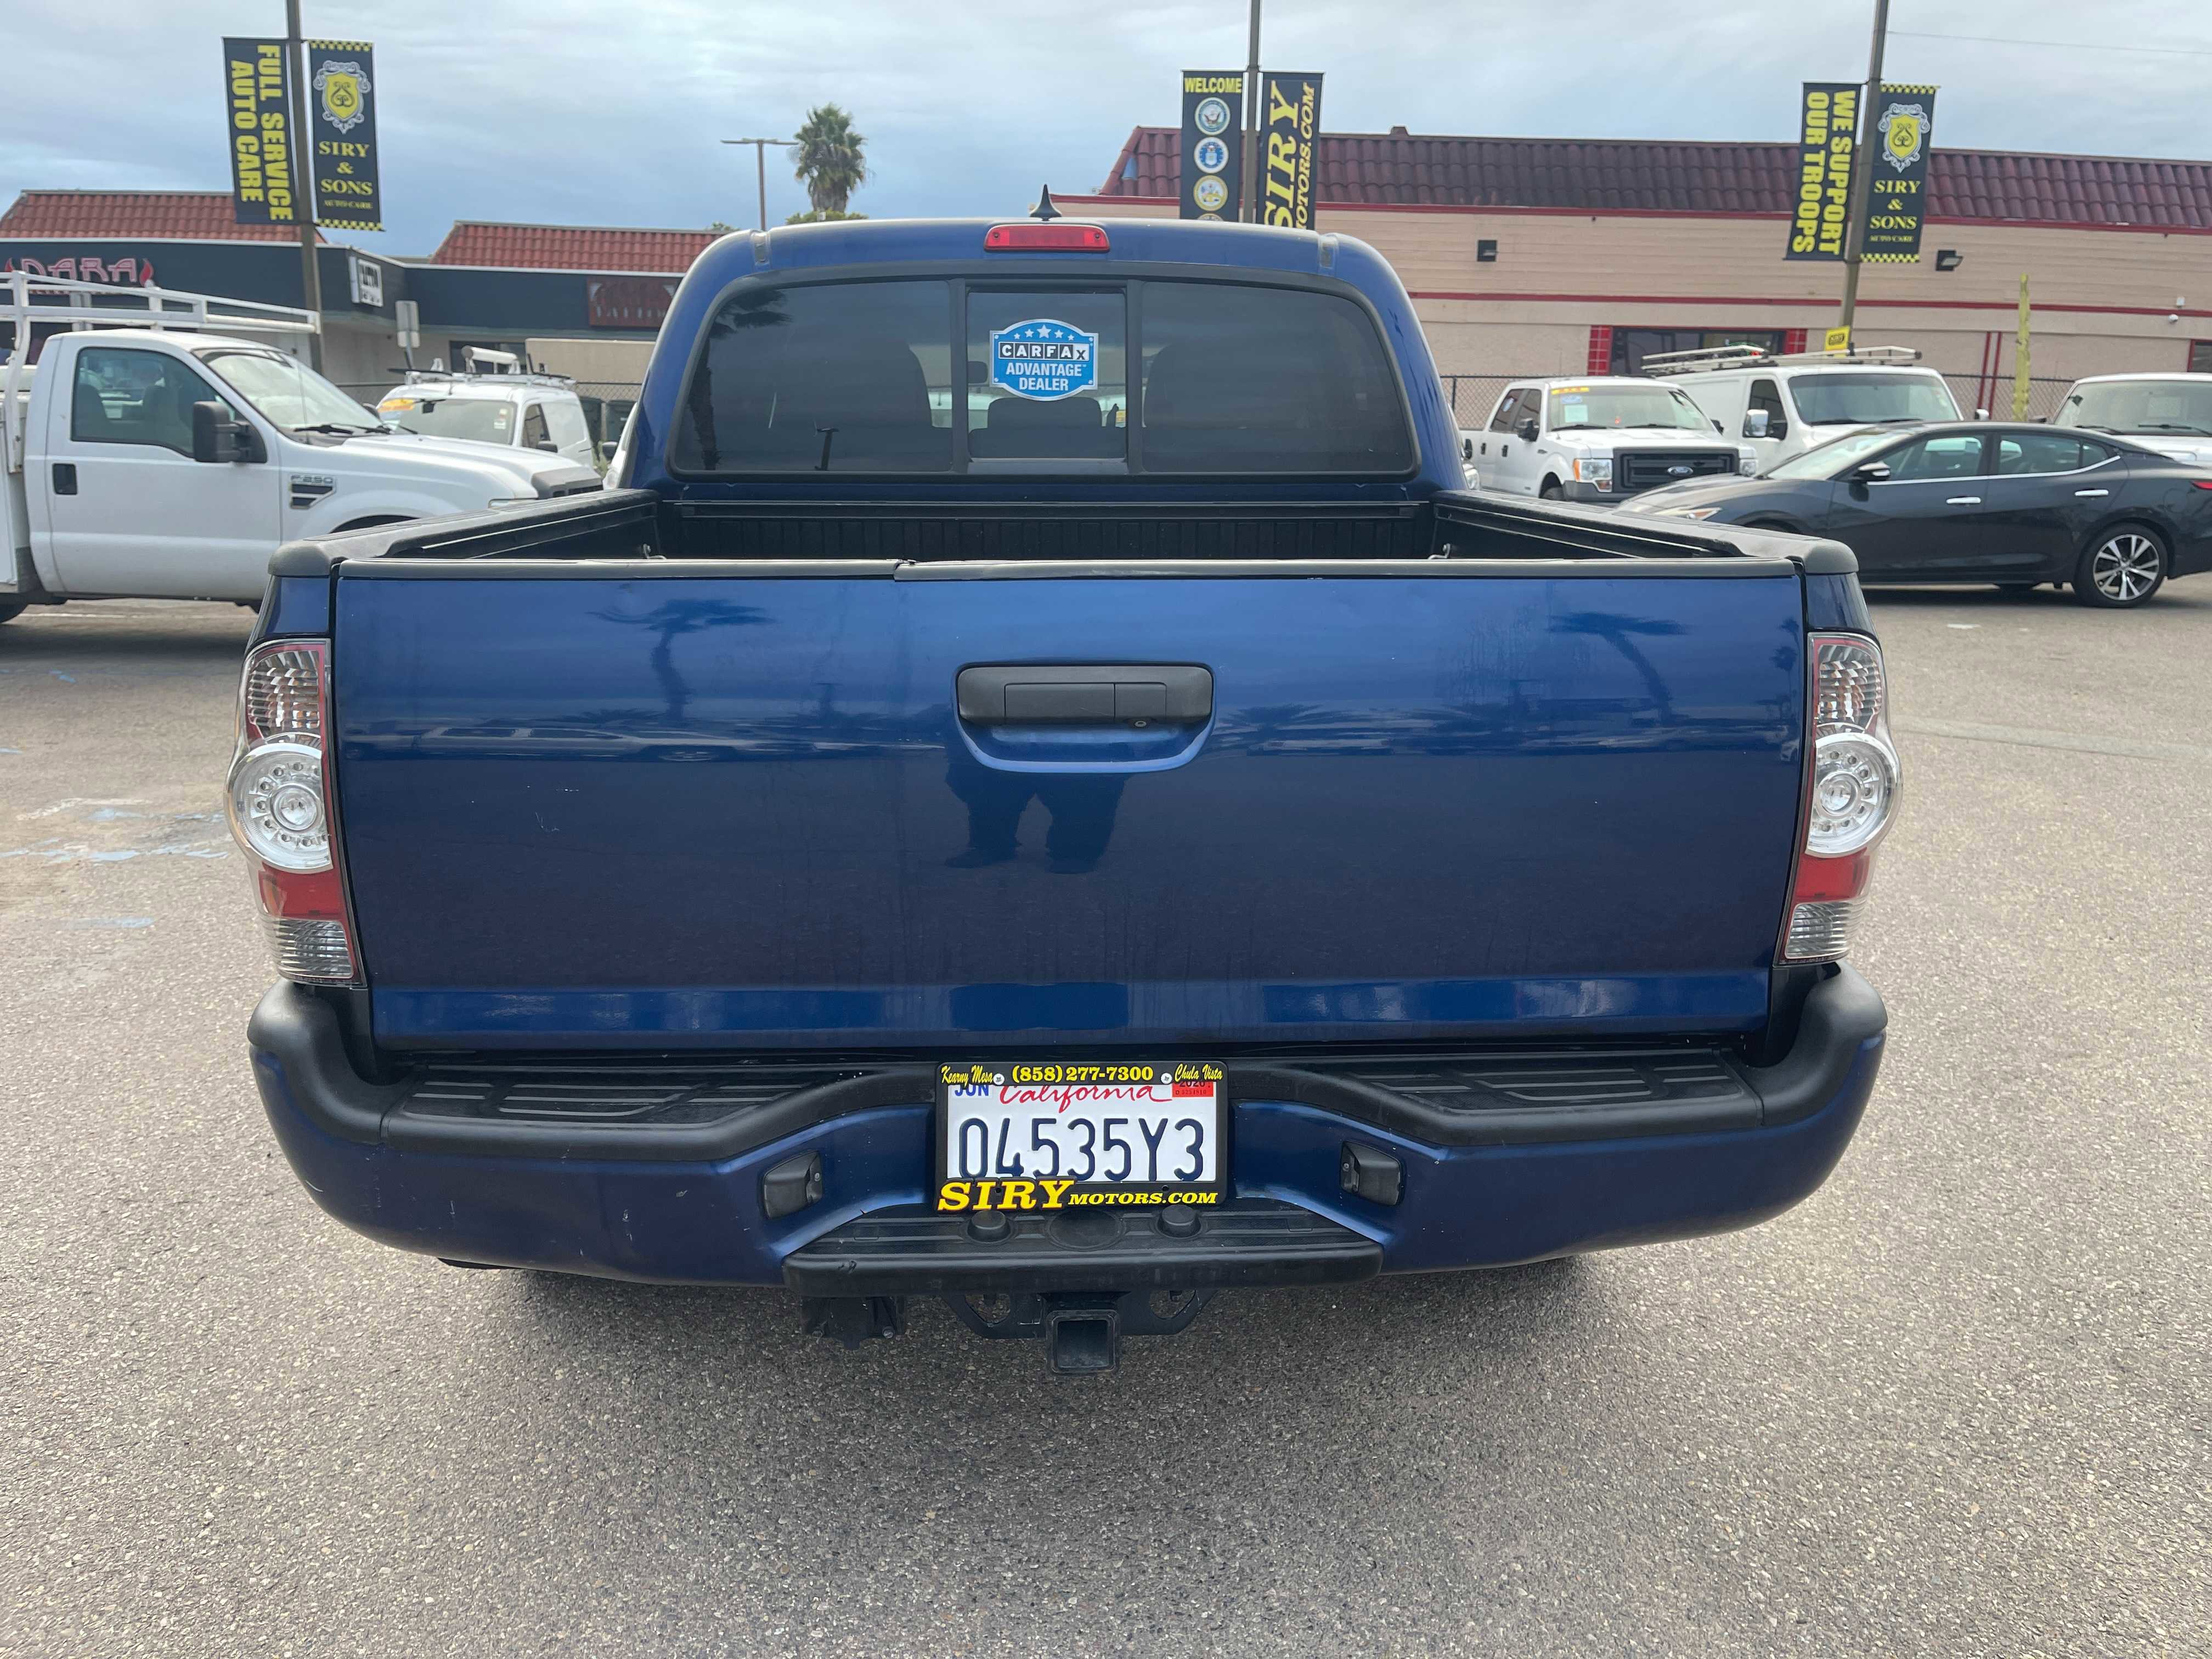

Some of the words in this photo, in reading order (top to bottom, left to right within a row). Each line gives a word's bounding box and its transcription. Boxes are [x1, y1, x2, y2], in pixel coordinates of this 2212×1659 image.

[257, 45, 283, 101] FULL
[231, 60, 258, 129] AUTO
[1184, 77, 1242, 93] WELCOME
[1805, 92, 1830, 145] OUR
[1832, 90, 1856, 132] WE
[319, 141, 370, 157] SIRY
[1264, 80, 1299, 228] SIRY
[236, 135, 264, 202] CARE
[261, 112, 294, 221] SERVICE
[337, 162, 354, 174] &
[320, 179, 373, 195] SONS
[1819, 137, 1853, 256] SUPPORT
[1874, 180, 1921, 194] SIRY
[1792, 149, 1826, 253] TROOPS
[1887, 199, 1904, 211] &
[1869, 216, 1917, 230] SONS
[1002, 345, 1086, 360] CARFAX
[1006, 363, 1082, 377] ADVANTAGE
[1019, 377, 1069, 391] DEALER
[941, 1065, 969, 1087] Kearny
[972, 1065, 994, 1084] Mesa
[1012, 1065, 1063, 1083] (858)
[1066, 1066, 1153, 1081] 277-7300
[1175, 1063, 1199, 1082] Chula
[1202, 1064, 1223, 1080] Vista
[955, 1084, 989, 1096] JUN
[1000, 1085, 1172, 1113] California
[959, 1118, 1204, 1182] 04535Y3
[938, 1180, 1075, 1211] SIRY
[1068, 1192, 1218, 1205] MOTORS.COM
